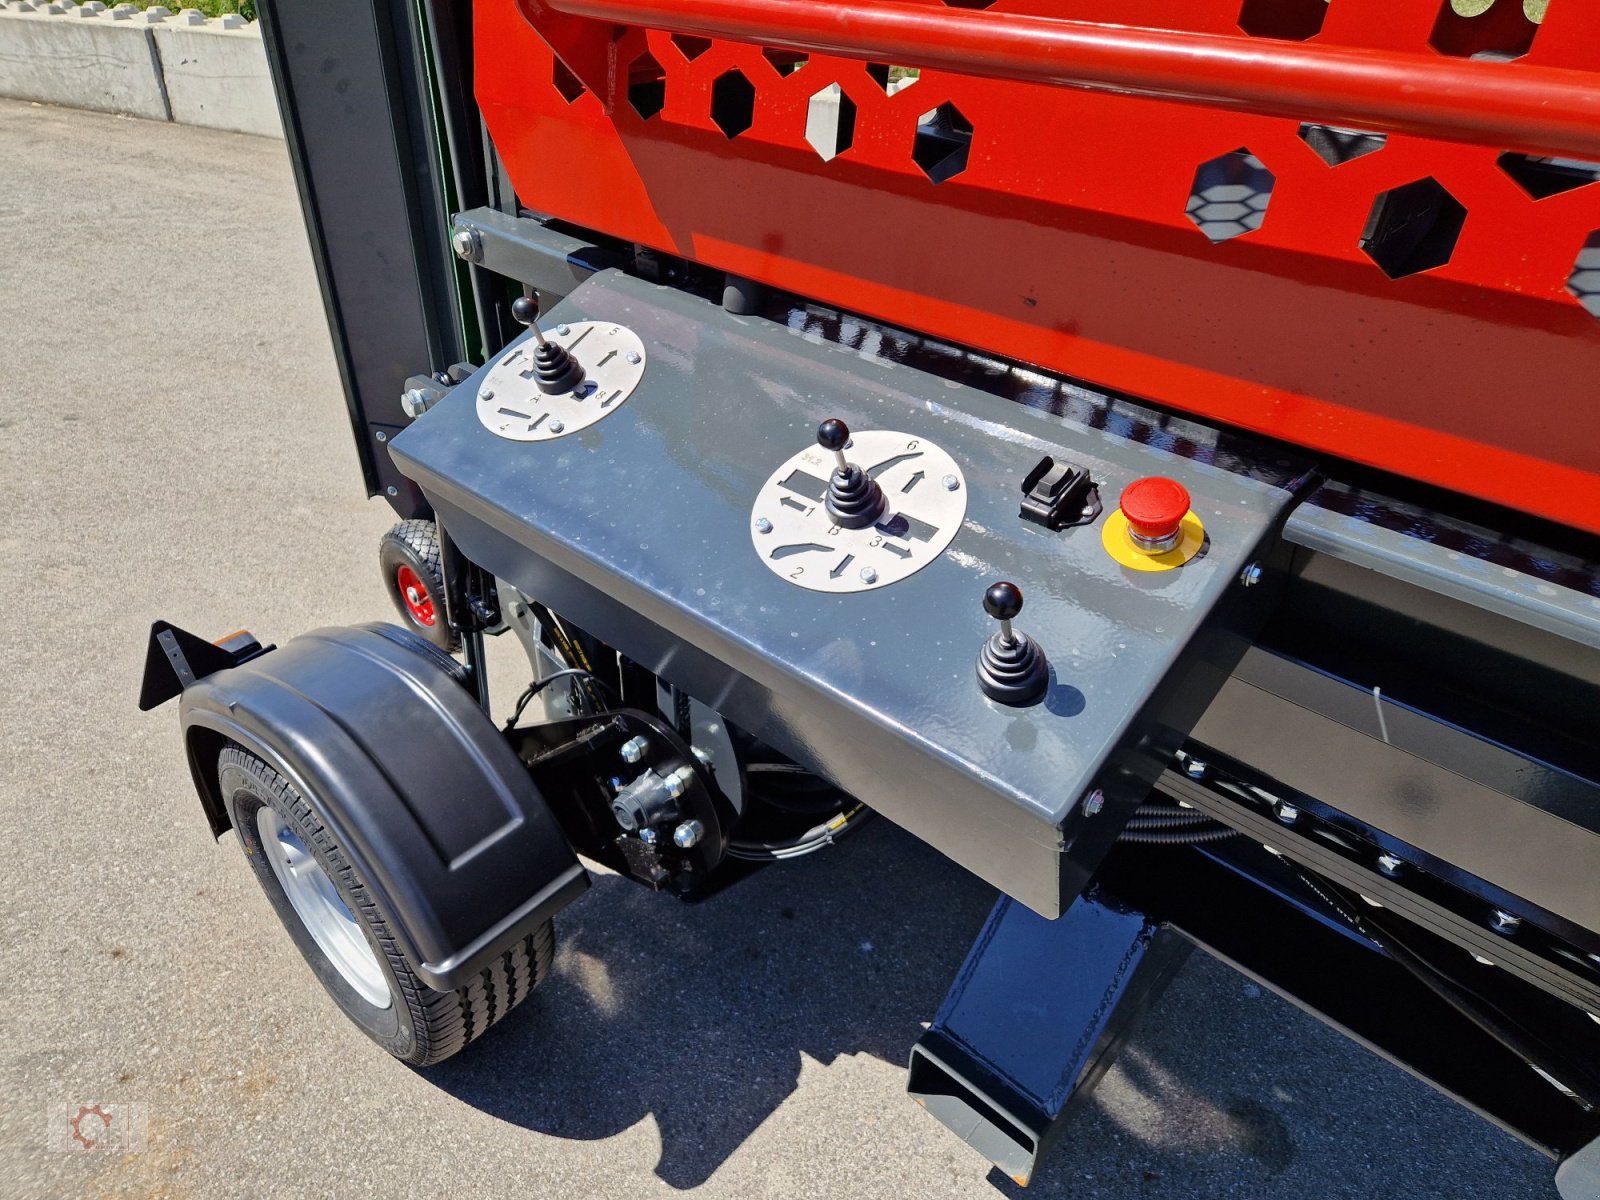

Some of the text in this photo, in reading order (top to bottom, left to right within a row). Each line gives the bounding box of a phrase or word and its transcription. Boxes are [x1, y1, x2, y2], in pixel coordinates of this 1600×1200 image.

[906, 440, 920, 451] 6
[805, 507, 816, 518] 1
[869, 535, 882, 548] 3
[790, 566, 804, 579] 2
